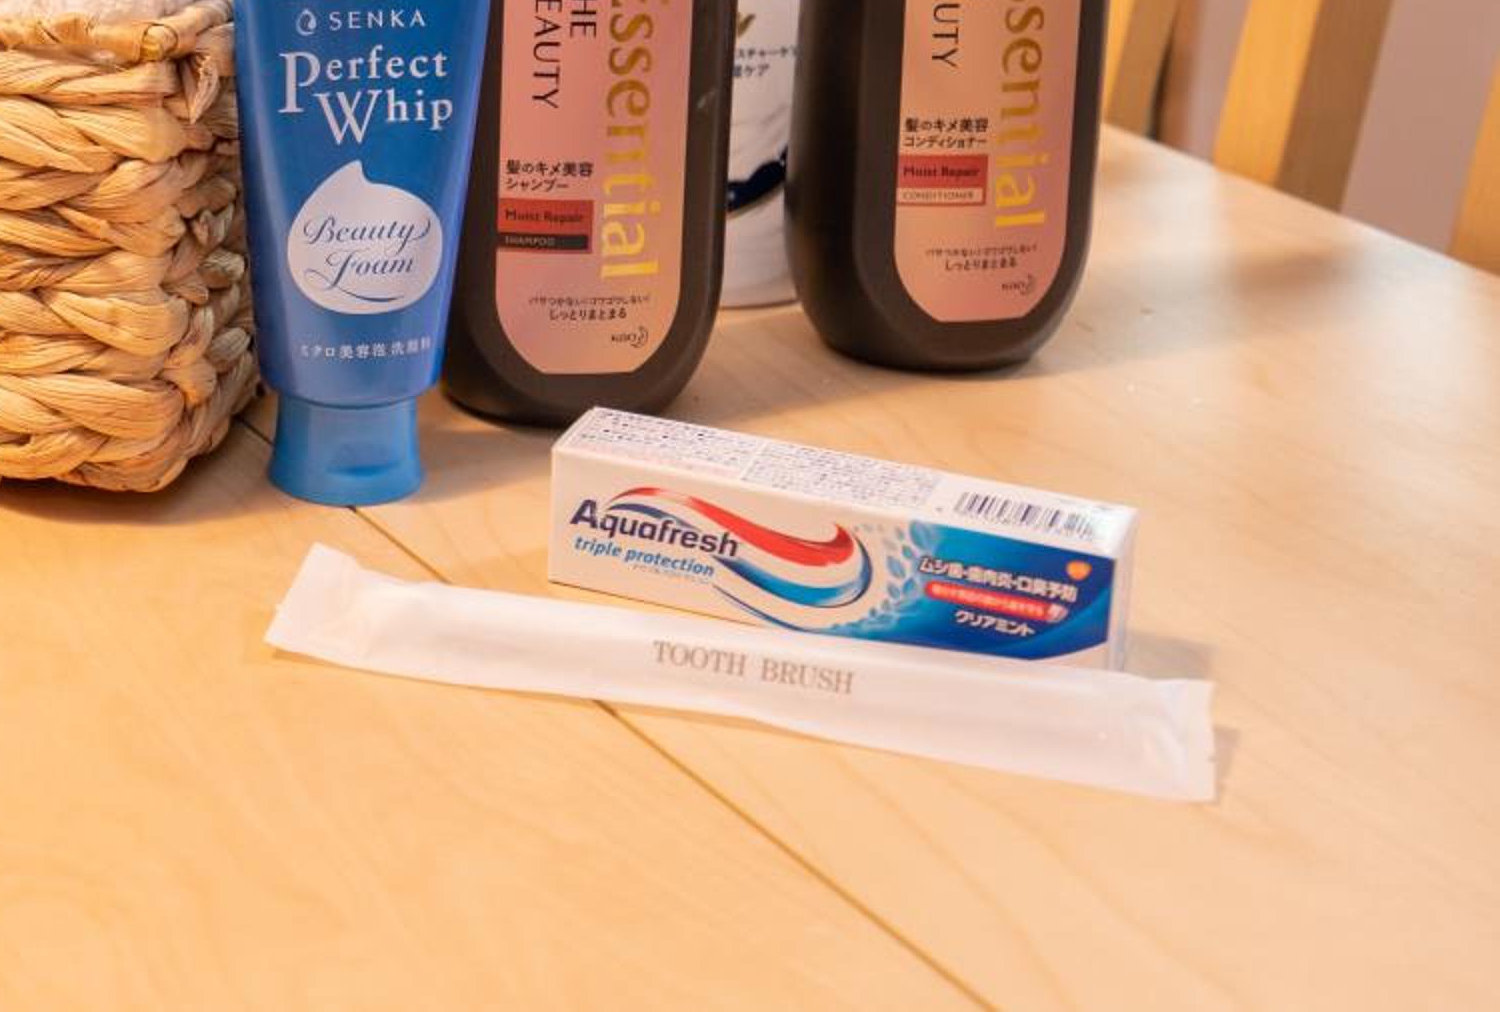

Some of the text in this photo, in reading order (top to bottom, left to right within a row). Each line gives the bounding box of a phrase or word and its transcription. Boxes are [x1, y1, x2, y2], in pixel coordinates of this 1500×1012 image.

[328, 9, 426, 31] SENKA
[278, 44, 448, 114] Perfect
[313, 88, 453, 145] Whip
[905, 117, 989, 134] 髪のキメ美容
[904, 135, 988, 149] コンディショナー
[505, 159, 595, 177] 髪のキメ美容
[506, 178, 570, 192] シャンプー
[303, 216, 431, 257] Beauty
[308, 248, 414, 294] Foam
[569, 499, 740, 557] Aquafresh
[574, 536, 623, 557] triple
[624, 547, 715, 578] protection
[954, 609, 1036, 637] クリアミント
[652, 639, 855, 695] TOOTH BRUSH
